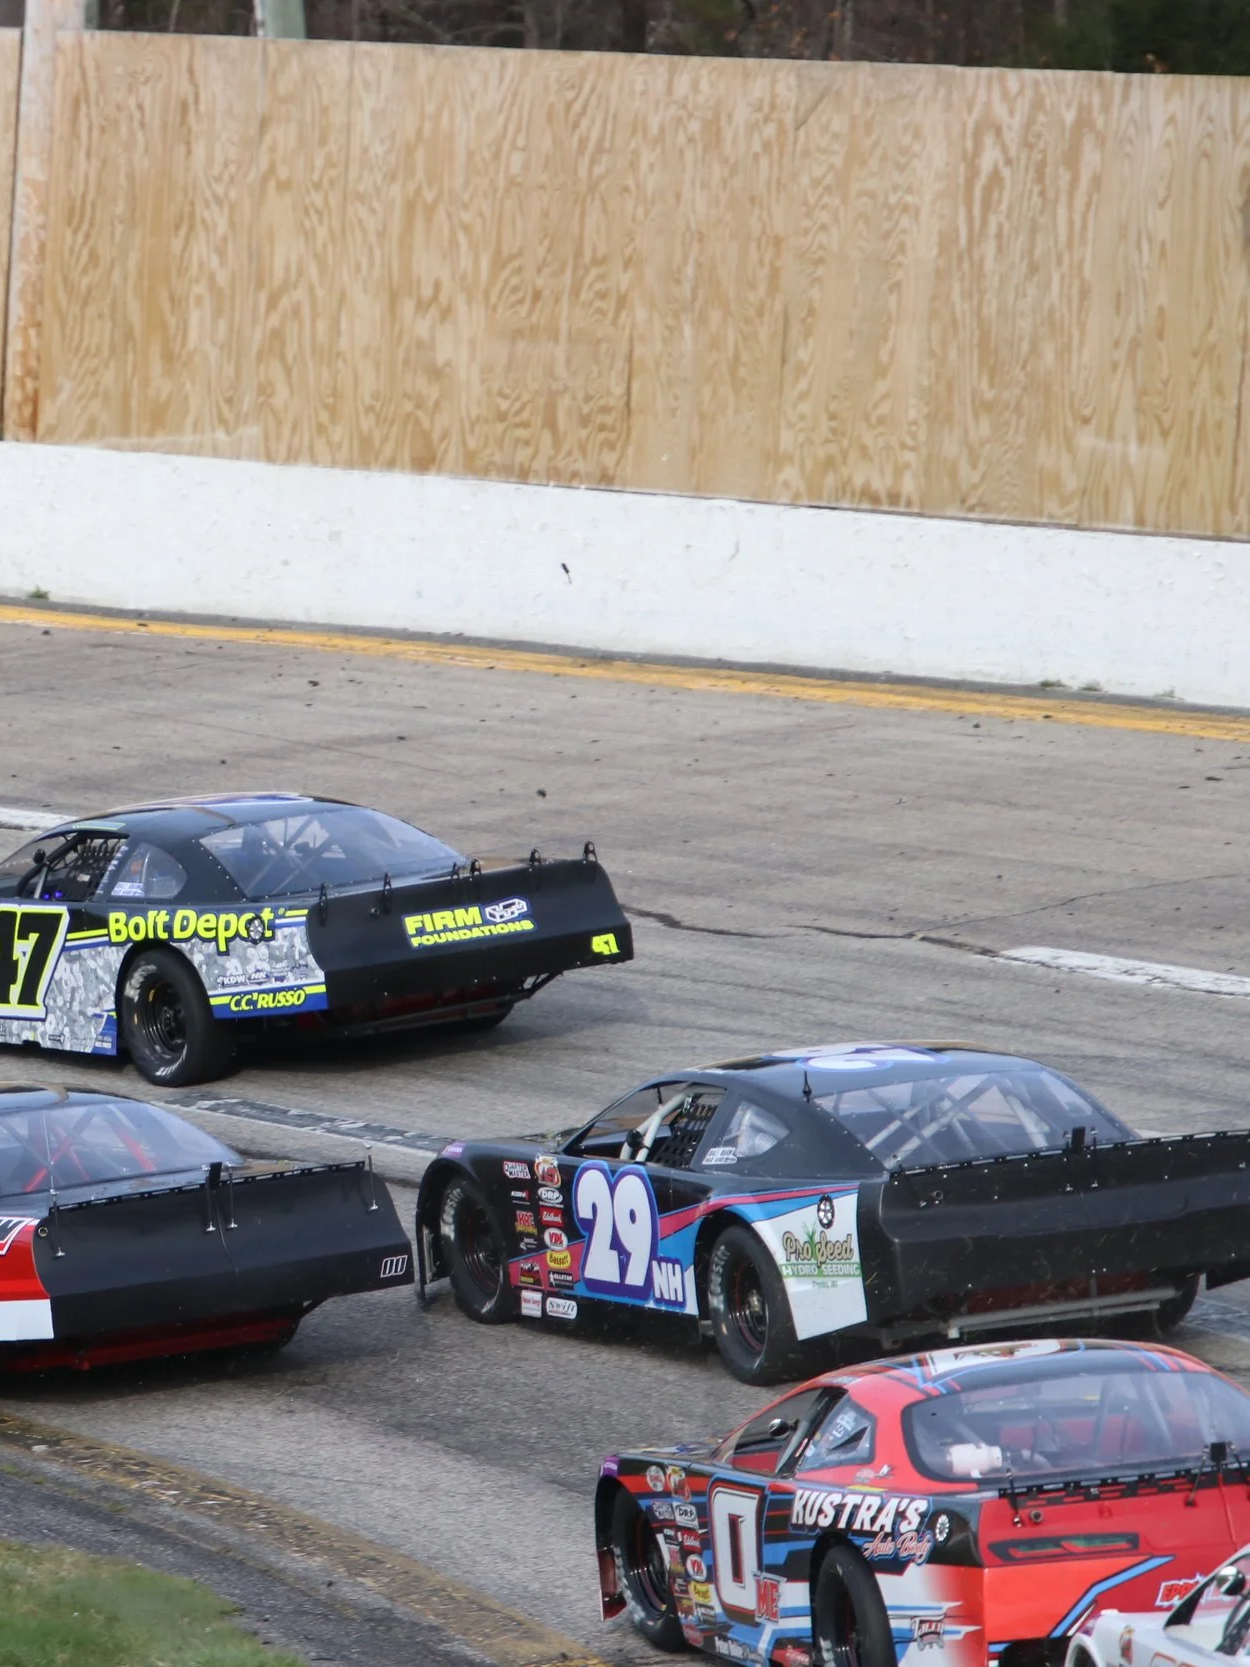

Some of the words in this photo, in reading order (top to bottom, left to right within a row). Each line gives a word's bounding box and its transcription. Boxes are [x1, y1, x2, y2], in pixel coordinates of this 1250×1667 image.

[108, 910, 168, 942] Bolt
[173, 908, 275, 952] Depot
[404, 906, 482, 935] FIRM
[411, 920, 535, 947] FOUNDATIONS
[576, 1166, 654, 1290] 29
[782, 1231, 812, 1261] Pro
[816, 1230, 854, 1267] Seed
[652, 1259, 684, 1302] NH
[781, 1263, 819, 1276] HYDRO
[823, 1263, 861, 1276] SEEDING
[791, 1489, 929, 1533] KUSTRA'S
[711, 1486, 760, 1612] 0
[863, 1532, 896, 1558] Auto
[896, 1530, 932, 1564] Body
[755, 1577, 780, 1623] ME
